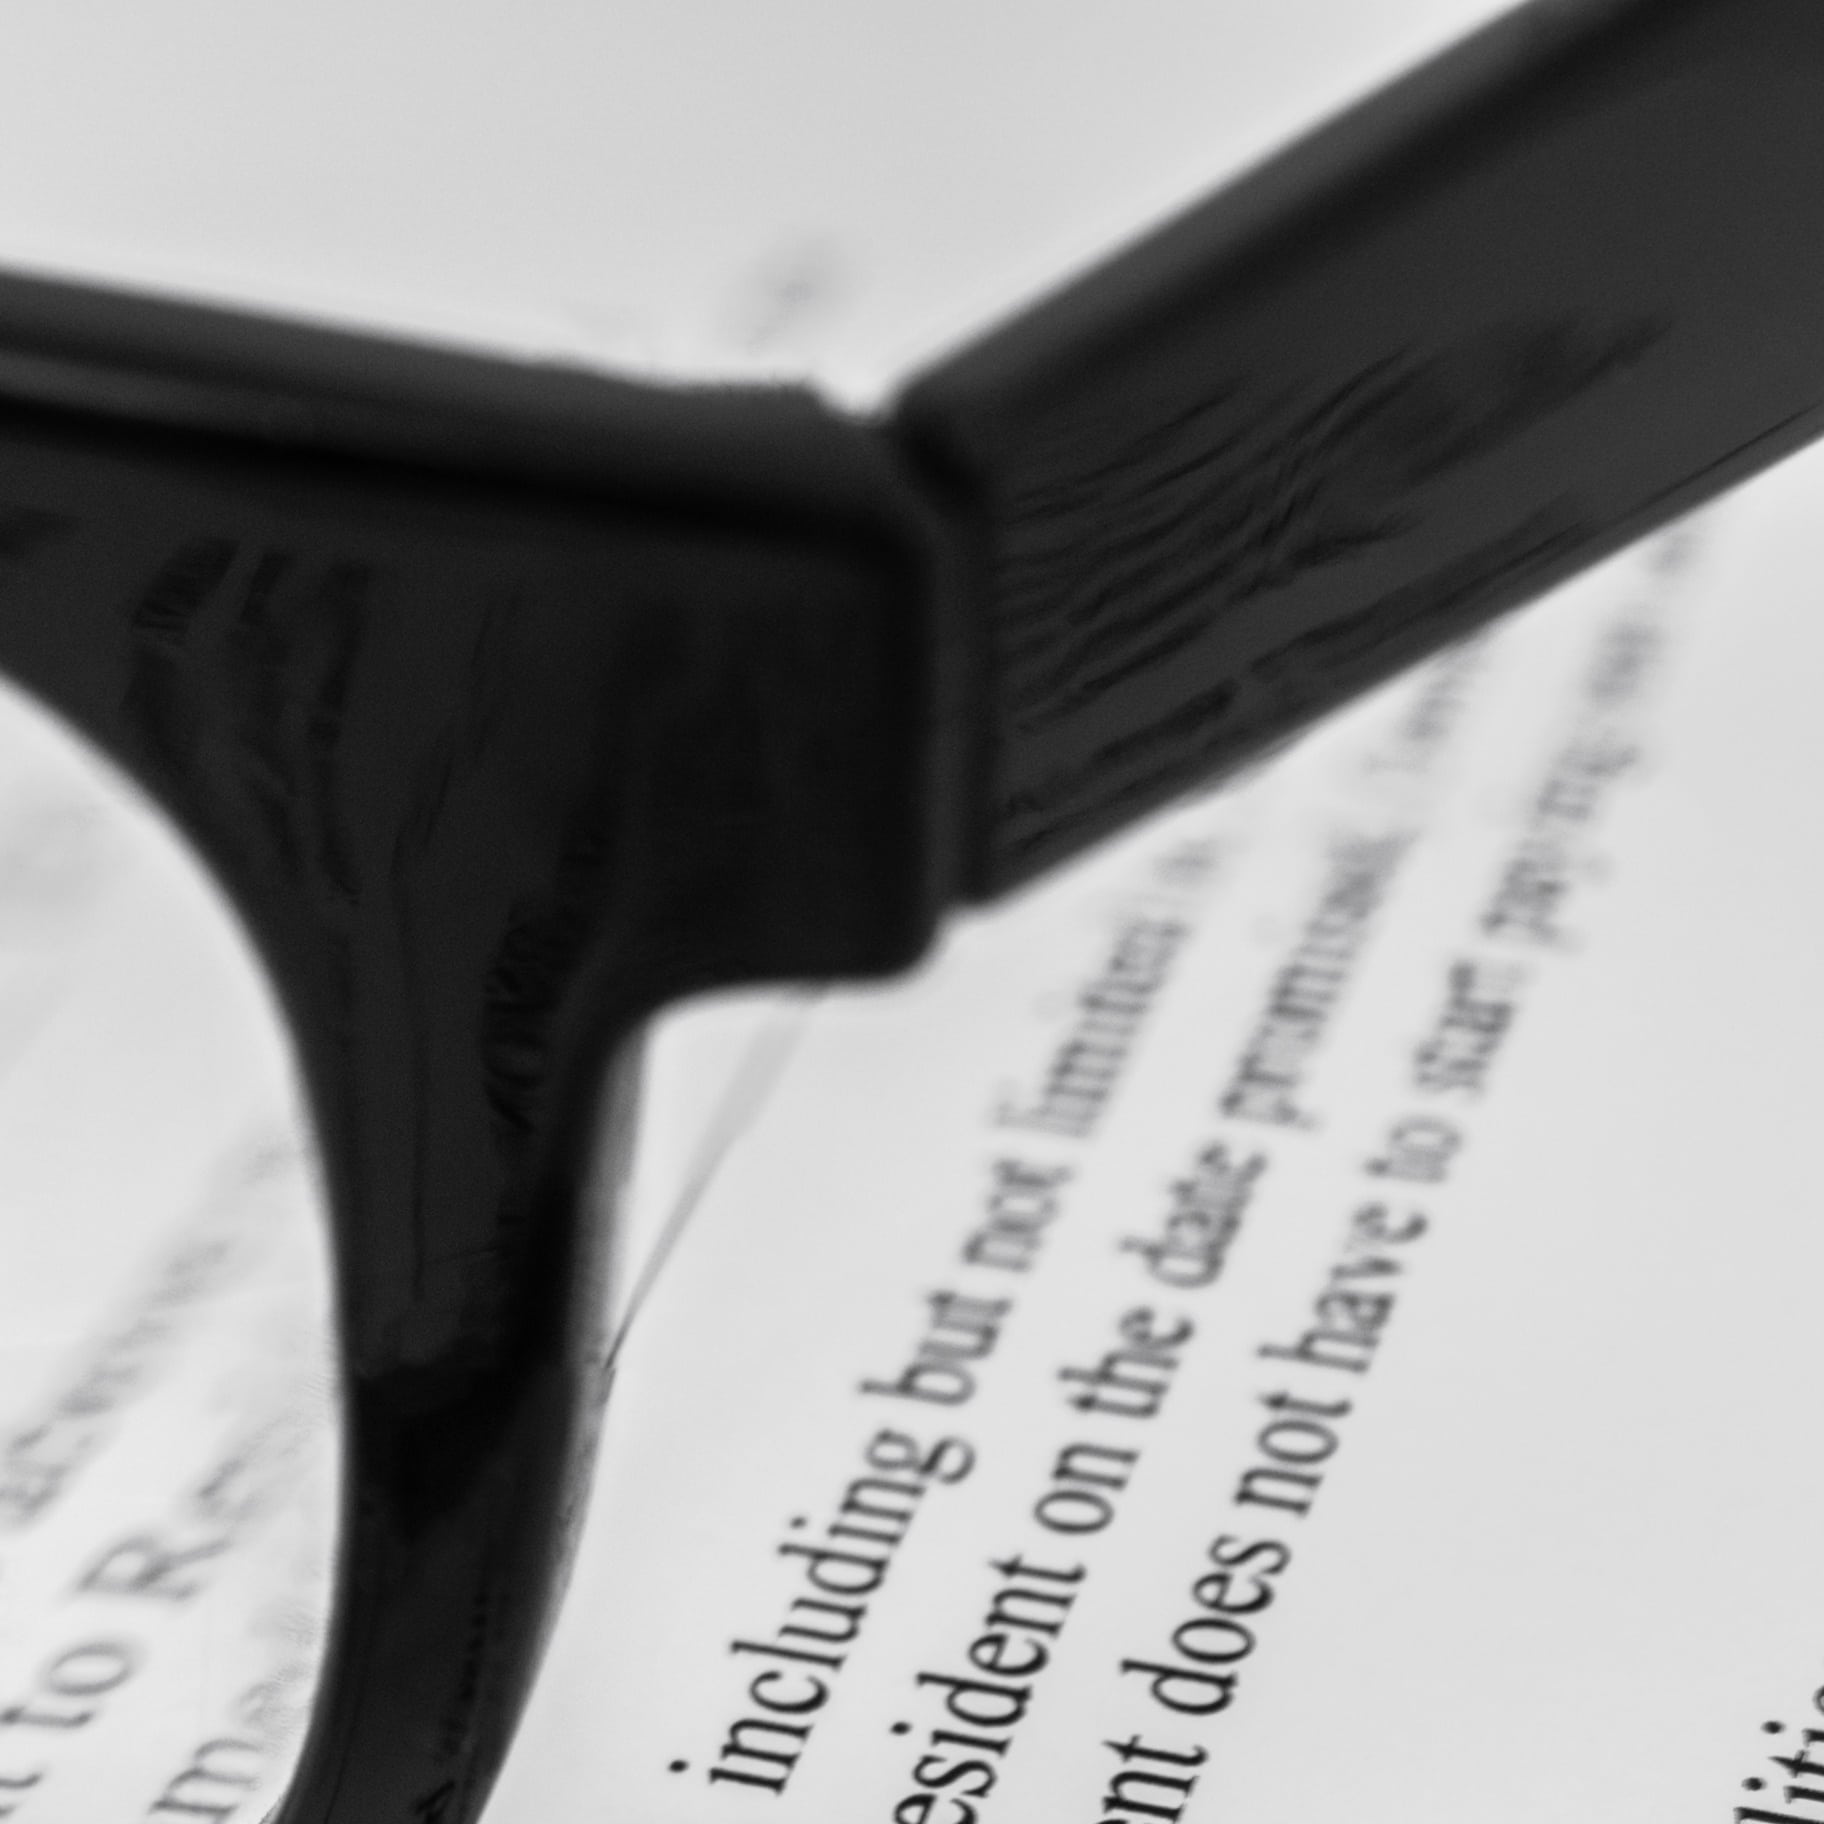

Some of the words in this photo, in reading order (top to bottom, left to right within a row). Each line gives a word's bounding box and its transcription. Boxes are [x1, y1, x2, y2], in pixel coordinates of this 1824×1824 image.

[1055, 1303, 1197, 1420] the
[1255, 1200, 1430, 1377] have
[1030, 1440, 1142, 1538] on
[1232, 1390, 1352, 1518] not
[665, 1428, 977, 1797] including
[857, 1288, 1015, 1408] but
[1117, 1533, 1295, 1717] does
